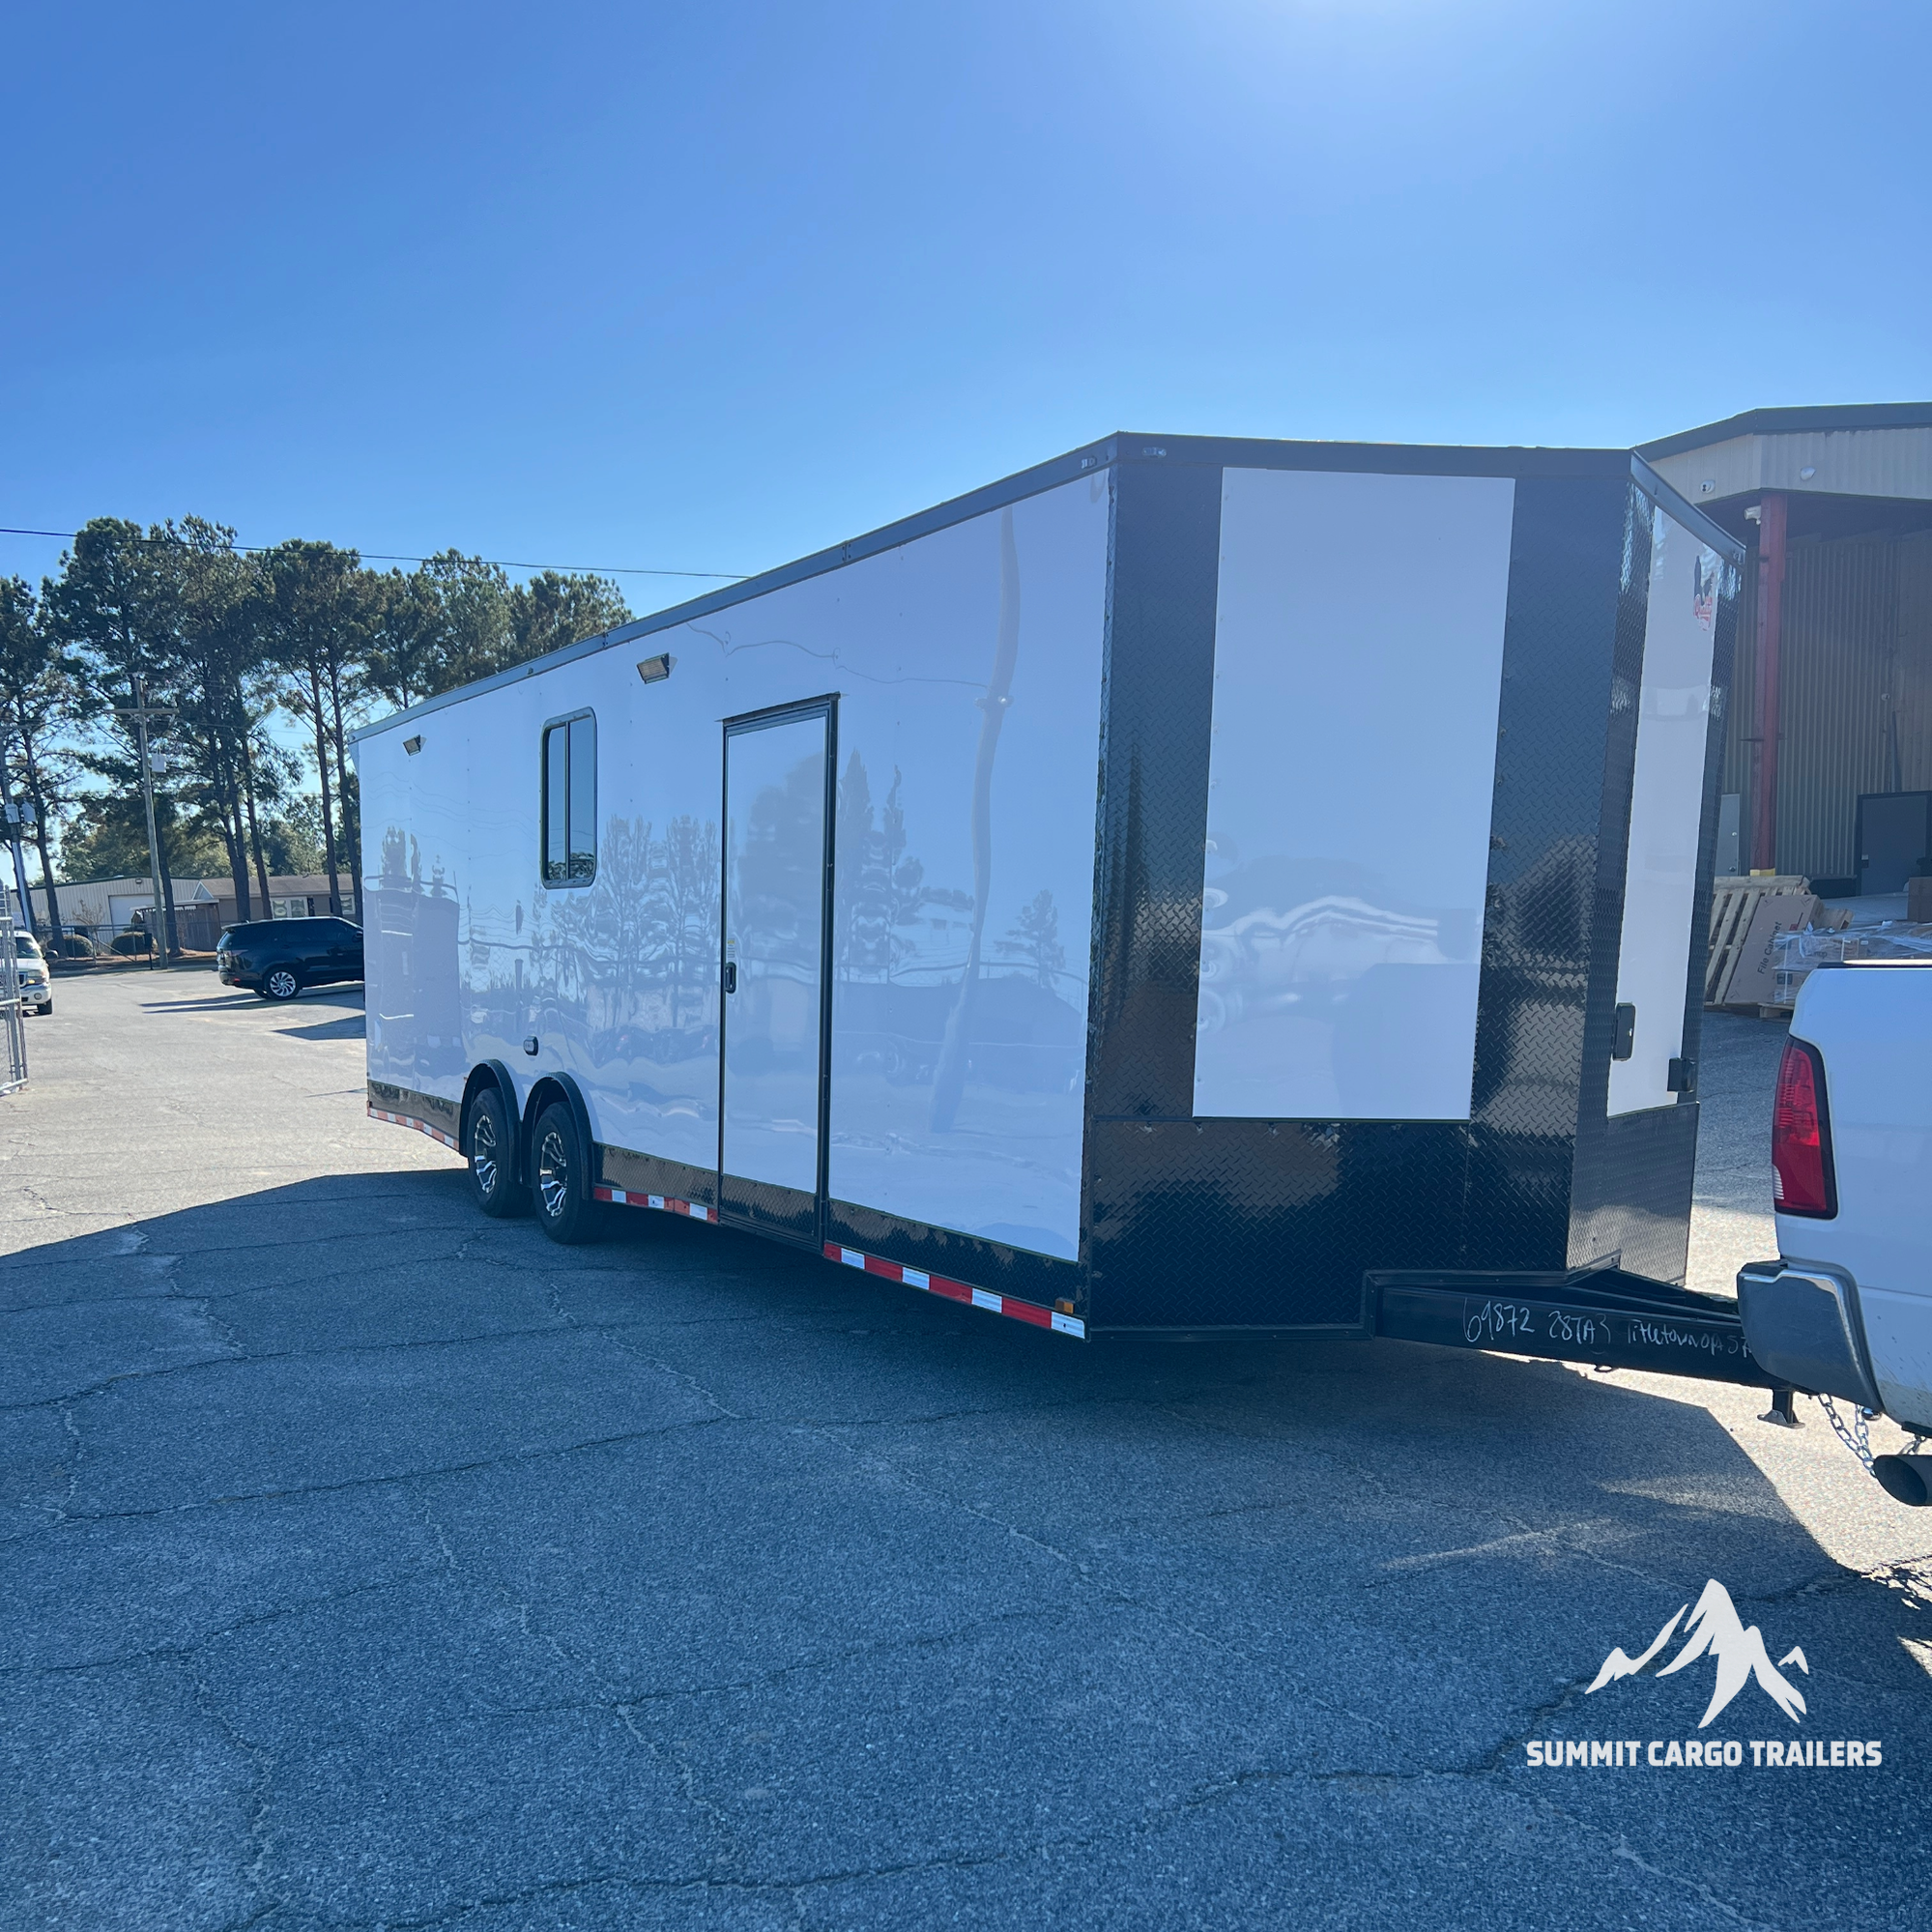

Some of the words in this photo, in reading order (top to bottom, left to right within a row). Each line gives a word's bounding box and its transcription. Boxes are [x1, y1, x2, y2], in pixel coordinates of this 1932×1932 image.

[1757, 957, 1770, 974] File
[1765, 921, 1782, 956] Cabinet
[1462, 1297, 1535, 1342] 69872
